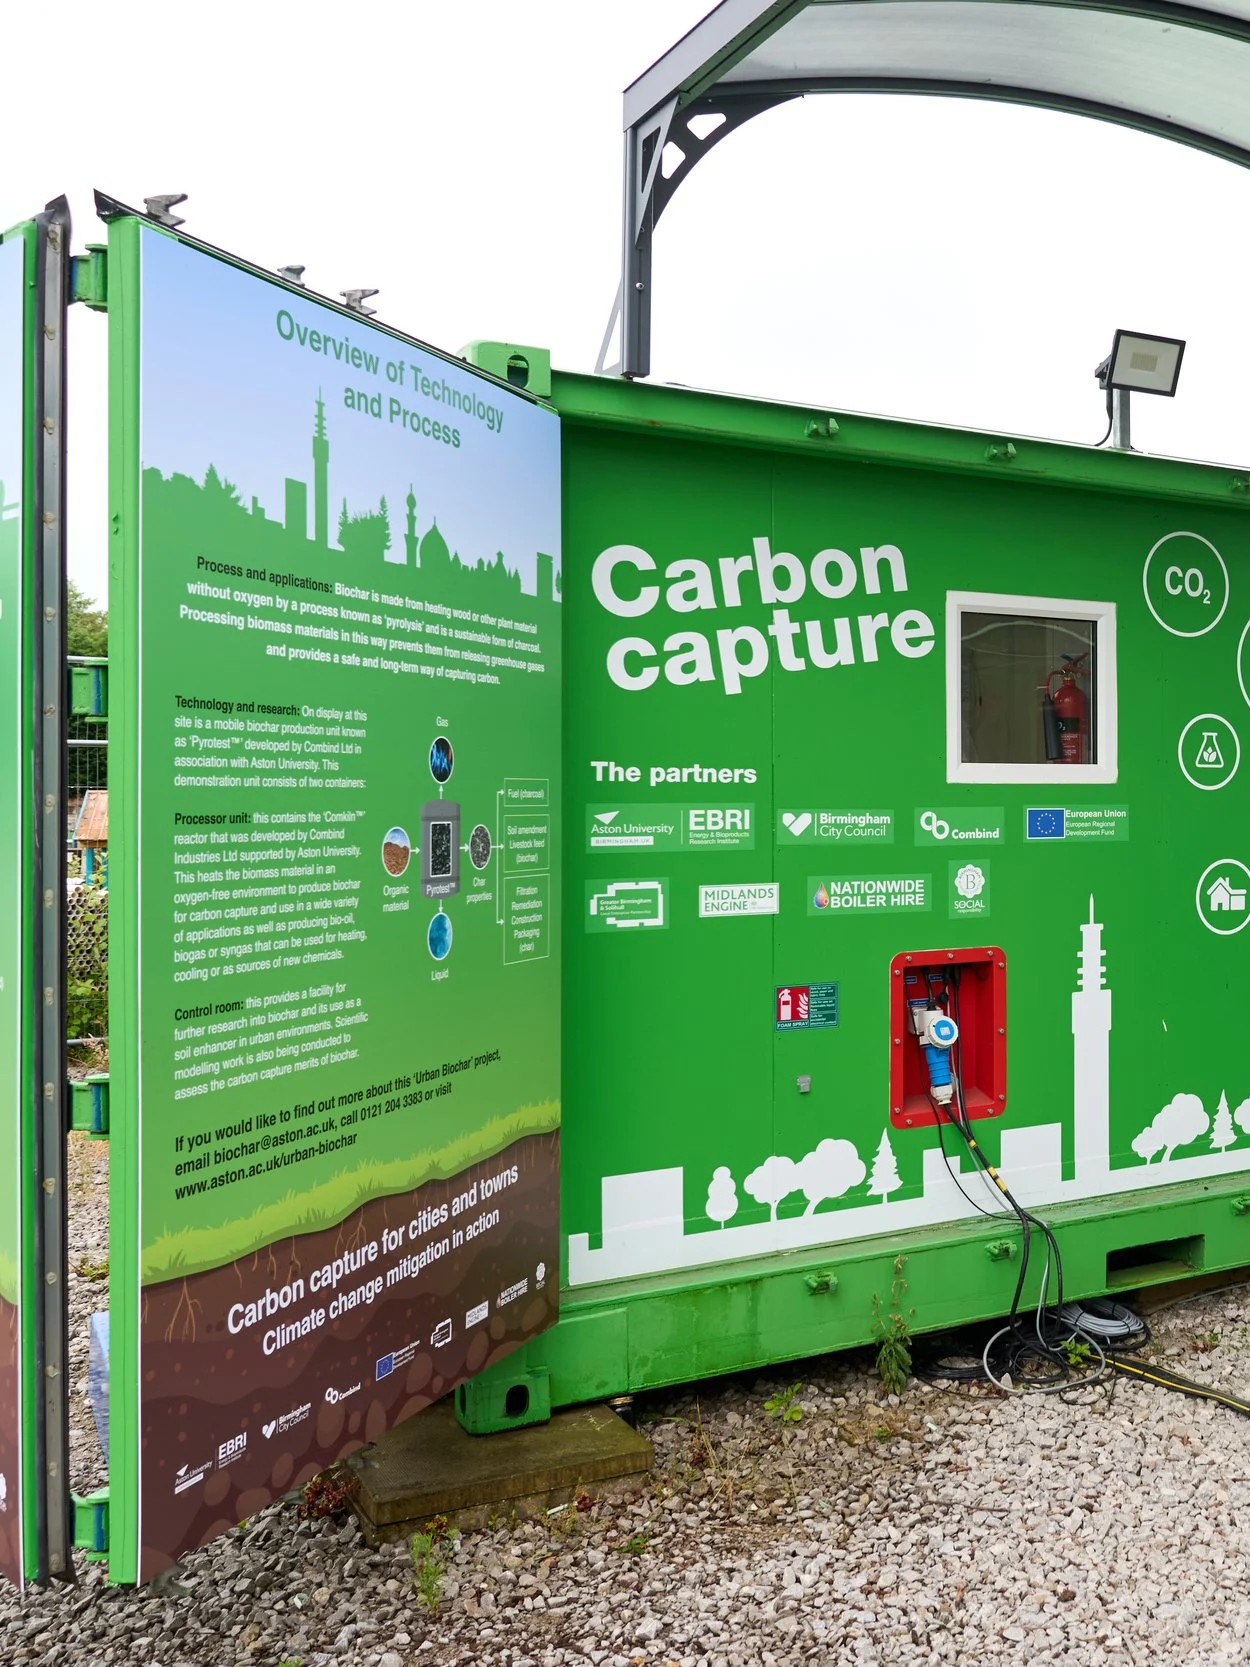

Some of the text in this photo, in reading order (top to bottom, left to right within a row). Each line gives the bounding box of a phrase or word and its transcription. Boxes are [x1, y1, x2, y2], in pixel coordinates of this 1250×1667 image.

[277, 310, 503, 433] Overview of Technology
[344, 387, 460, 448] and Process
[591, 536, 908, 618] Carbon
[197, 556, 537, 634] Process and applications: Biochar is made from heating wood or other plant material
[188, 582, 541, 653] without oxygen by a process known as 'pyrolysis' and is a sustainable form of charcoal.
[180, 605, 545, 672] Processing biomass materials in this way prevents them from releasing greenhouse gases
[606, 607, 935, 695] capture
[266, 644, 500, 684] and provides a safe and long-term way of capturing carbon.
[175, 695, 367, 721] Technology and research: On display at this
[436, 717, 448, 727] Gas
[591, 761, 757, 785] The partners
[175, 812, 251, 825] Processor unit:
[689, 810, 750, 830] EBRI
[820, 813, 890, 826] Birmingham
[1066, 810, 1126, 819] European Union
[591, 824, 674, 835] Aston University
[820, 825, 886, 839] City Council
[1066, 820, 1115, 829] European Regional
[952, 828, 999, 839] Combind
[1066, 829, 1099, 837] Development
[473, 877, 486, 887] Char
[831, 880, 924, 894] NATIONWIDE
[383, 885, 409, 897] Organic
[704, 888, 774, 901] MIDLANDS
[383, 900, 409, 912] material
[705, 901, 748, 912] ENGINE
[831, 893, 924, 908] BOILER HIRE
[954, 900, 985, 909] SOCIAL
[431, 968, 448, 981] Liquid
[175, 1001, 244, 1021] Control room:
[175, 1050, 501, 1152] If you would like to find out more about this 'Urban Biochar' project,
[175, 1082, 452, 1176] email biochar@aston.ac.uk, call 0121 204 3383 or visit
[175, 1132, 357, 1200] www.aston.ac.uk/urban-biochar
[227, 1165, 519, 1335] Carbon capture for cities and towns
[263, 1209, 499, 1355] Climate change mitigation in action
